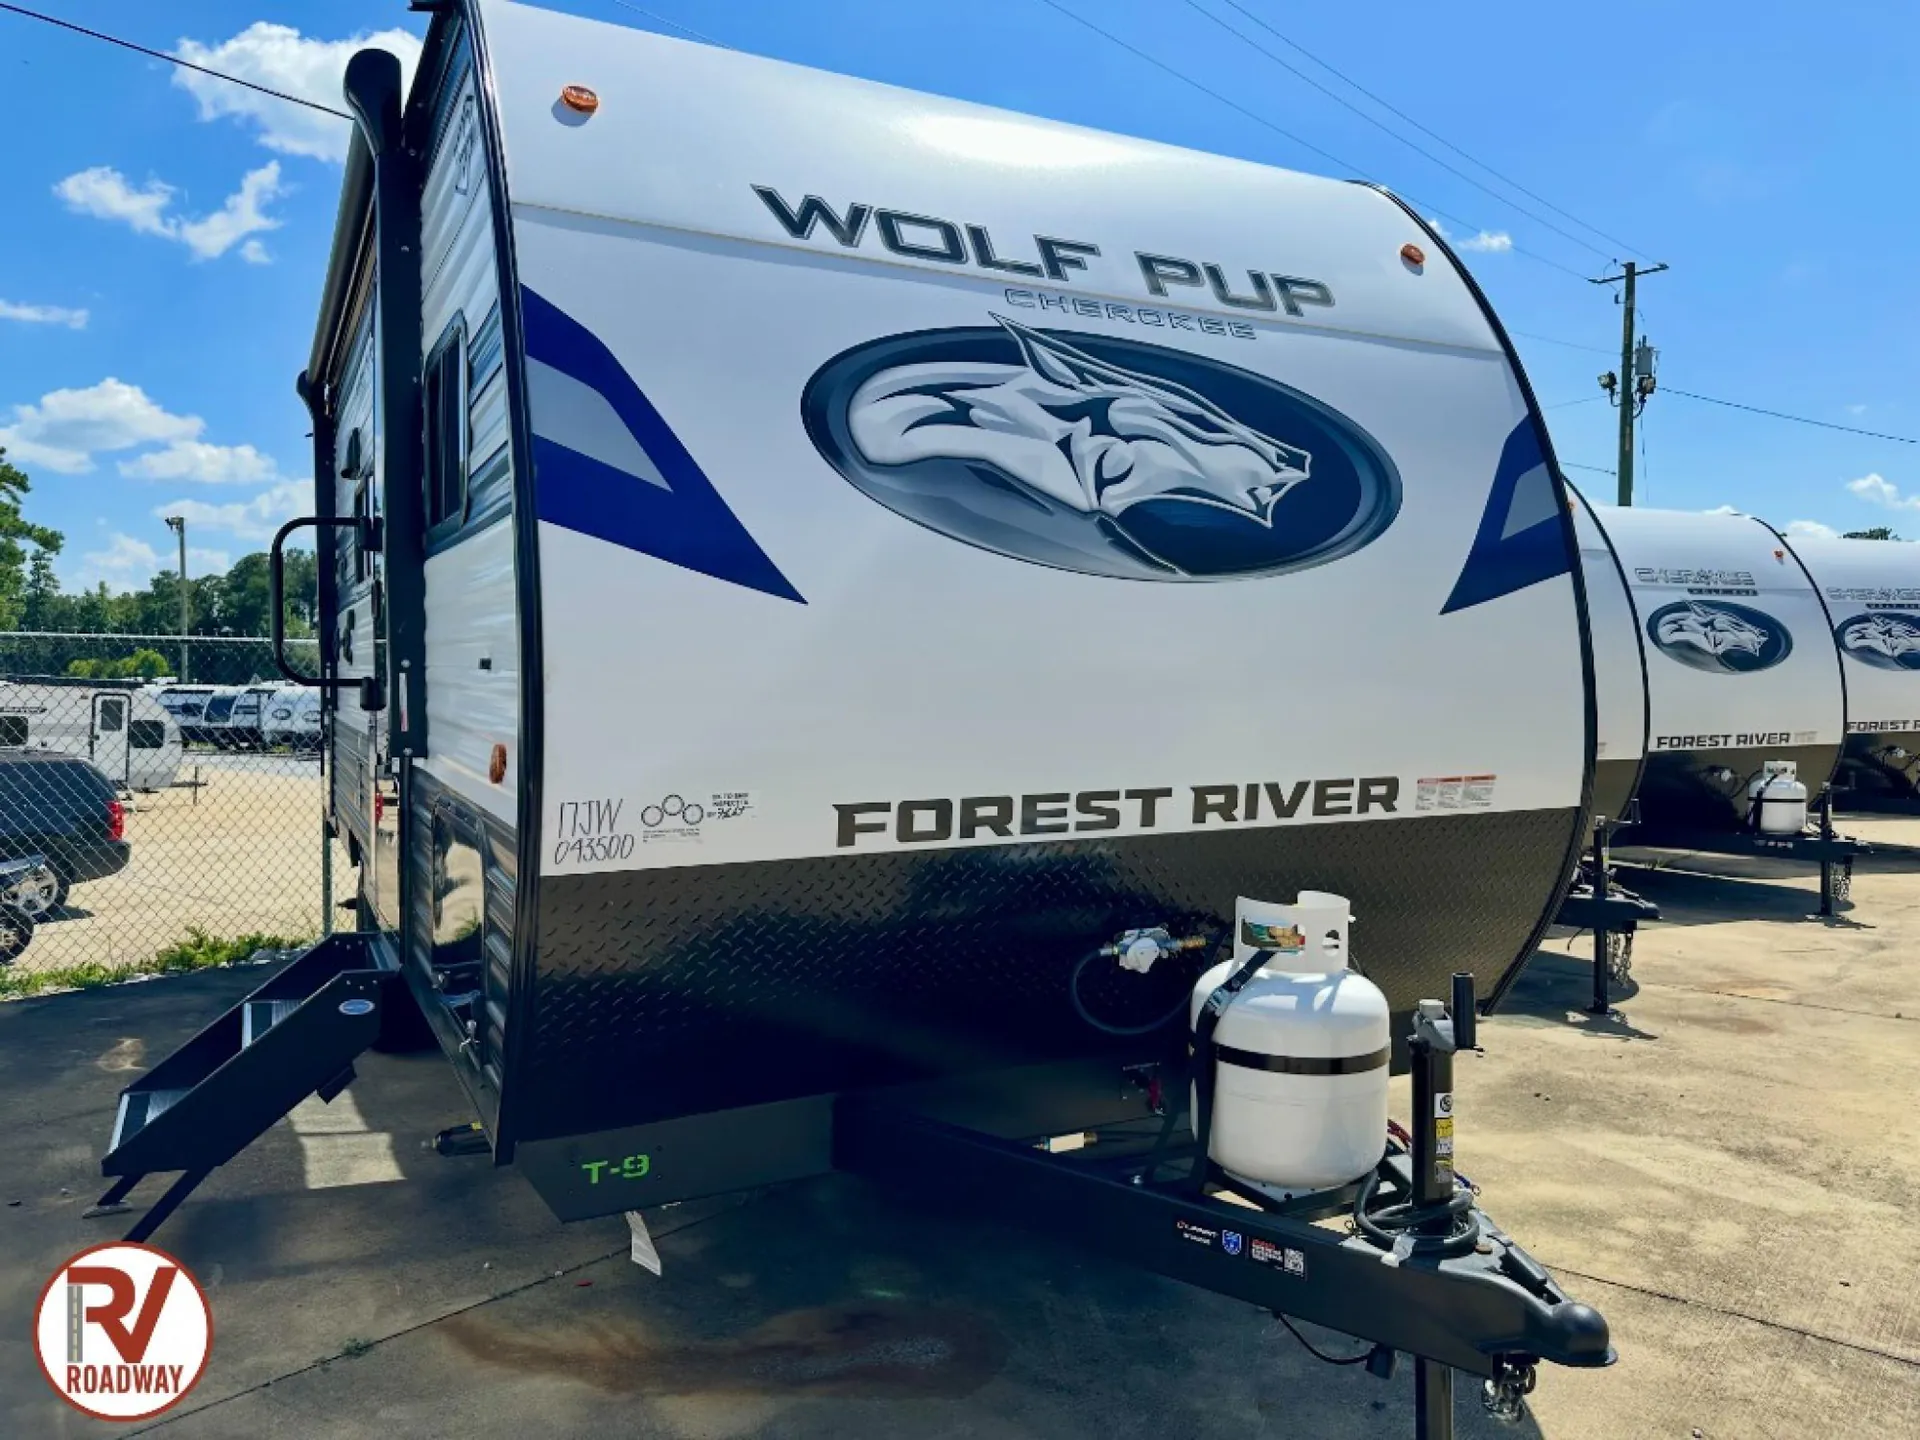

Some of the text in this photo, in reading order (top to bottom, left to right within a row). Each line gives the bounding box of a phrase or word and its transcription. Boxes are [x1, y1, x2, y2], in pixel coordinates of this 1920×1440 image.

[750, 183, 1335, 317] WOLF PUP
[1004, 287, 1257, 340] CHEROKEE
[1656, 735, 1732, 749] FOREST
[1735, 732, 1791, 746] RIVER
[832, 787, 1173, 848] FOREST
[1189, 776, 1399, 824] RIVER
[582, 1154, 650, 1184] T-9
